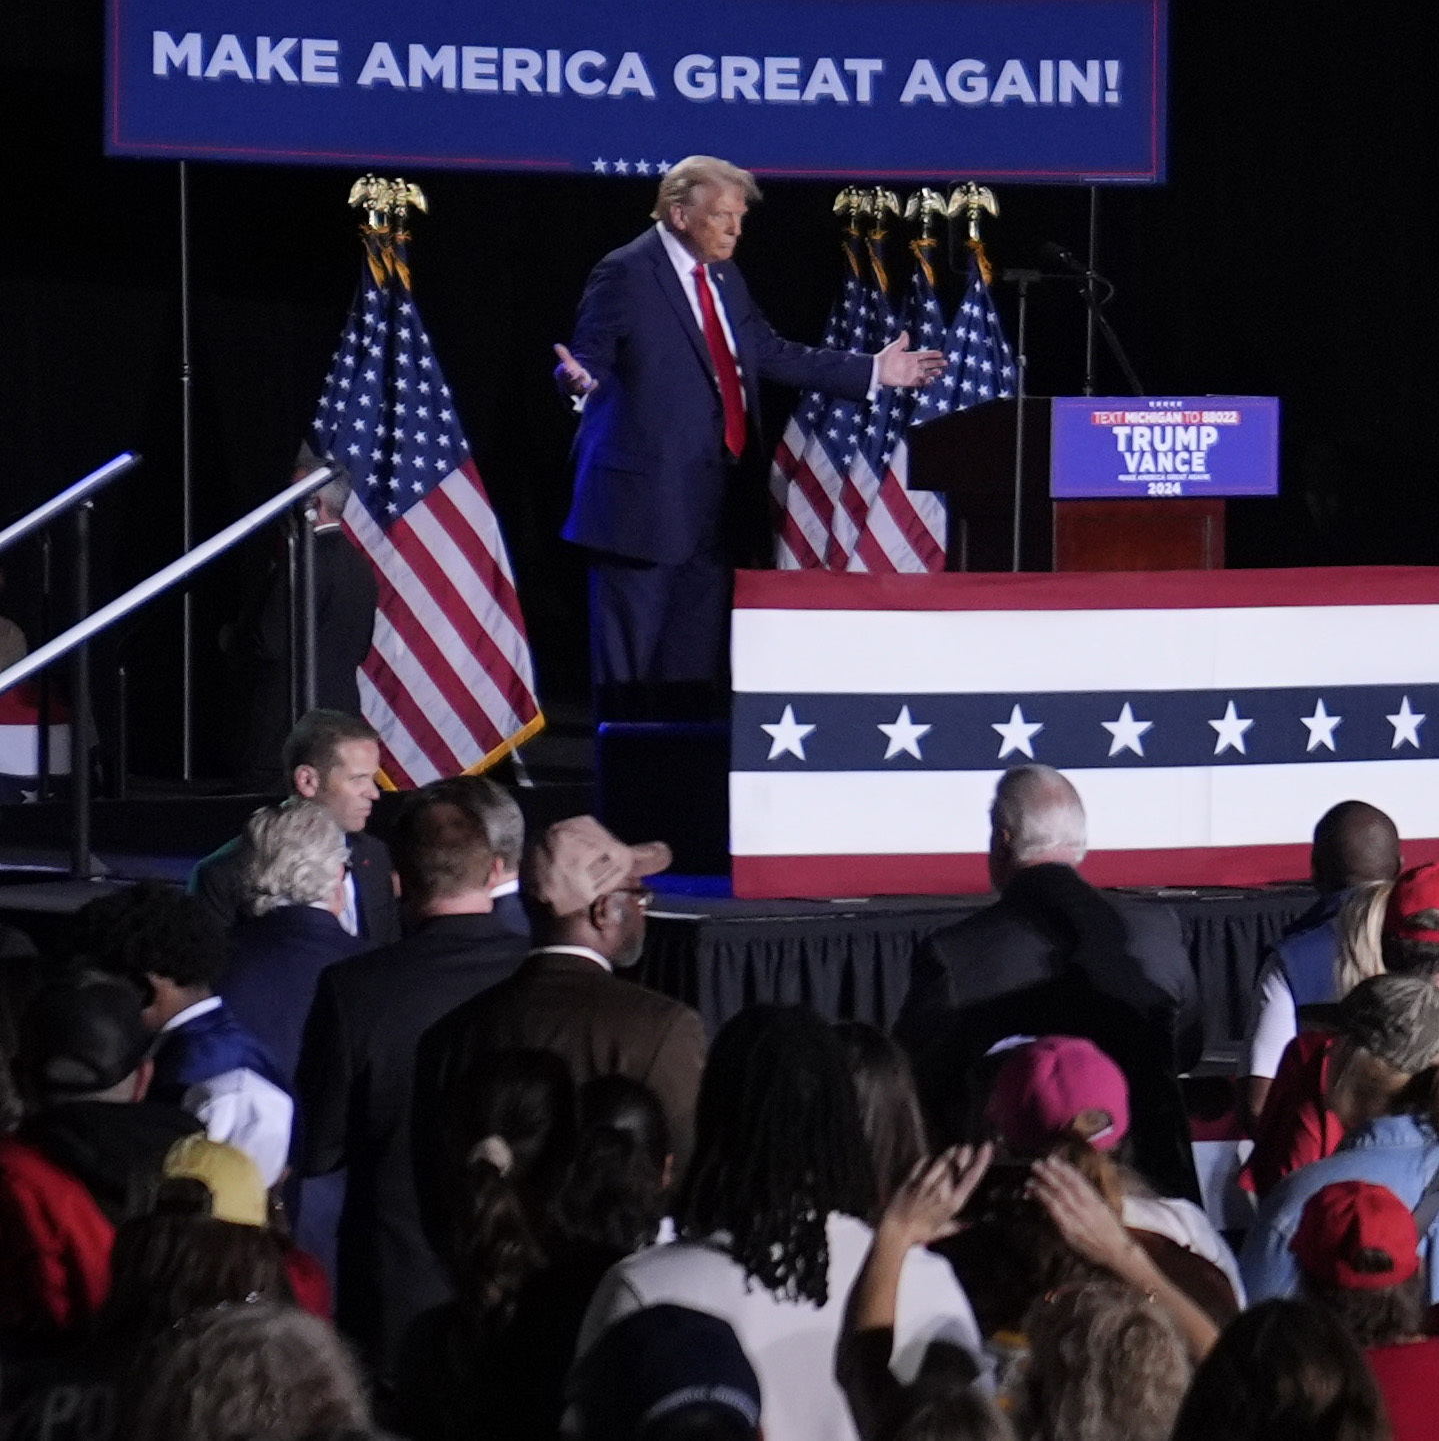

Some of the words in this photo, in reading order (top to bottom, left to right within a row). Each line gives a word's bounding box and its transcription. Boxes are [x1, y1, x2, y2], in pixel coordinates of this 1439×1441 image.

[152, 30, 341, 84] MAKE
[357, 41, 656, 99] AMERICA
[673, 53, 884, 104] GREAT
[899, 58, 1121, 106] AGAIN!
[1095, 411, 1124, 425] TEXT
[1124, 411, 1182, 424] MICHIGAN
[1184, 411, 1200, 424] TO
[1112, 426, 1219, 452] TRUMP
[1124, 451, 1206, 473] VANCE
[1147, 482, 1181, 496] 2024
